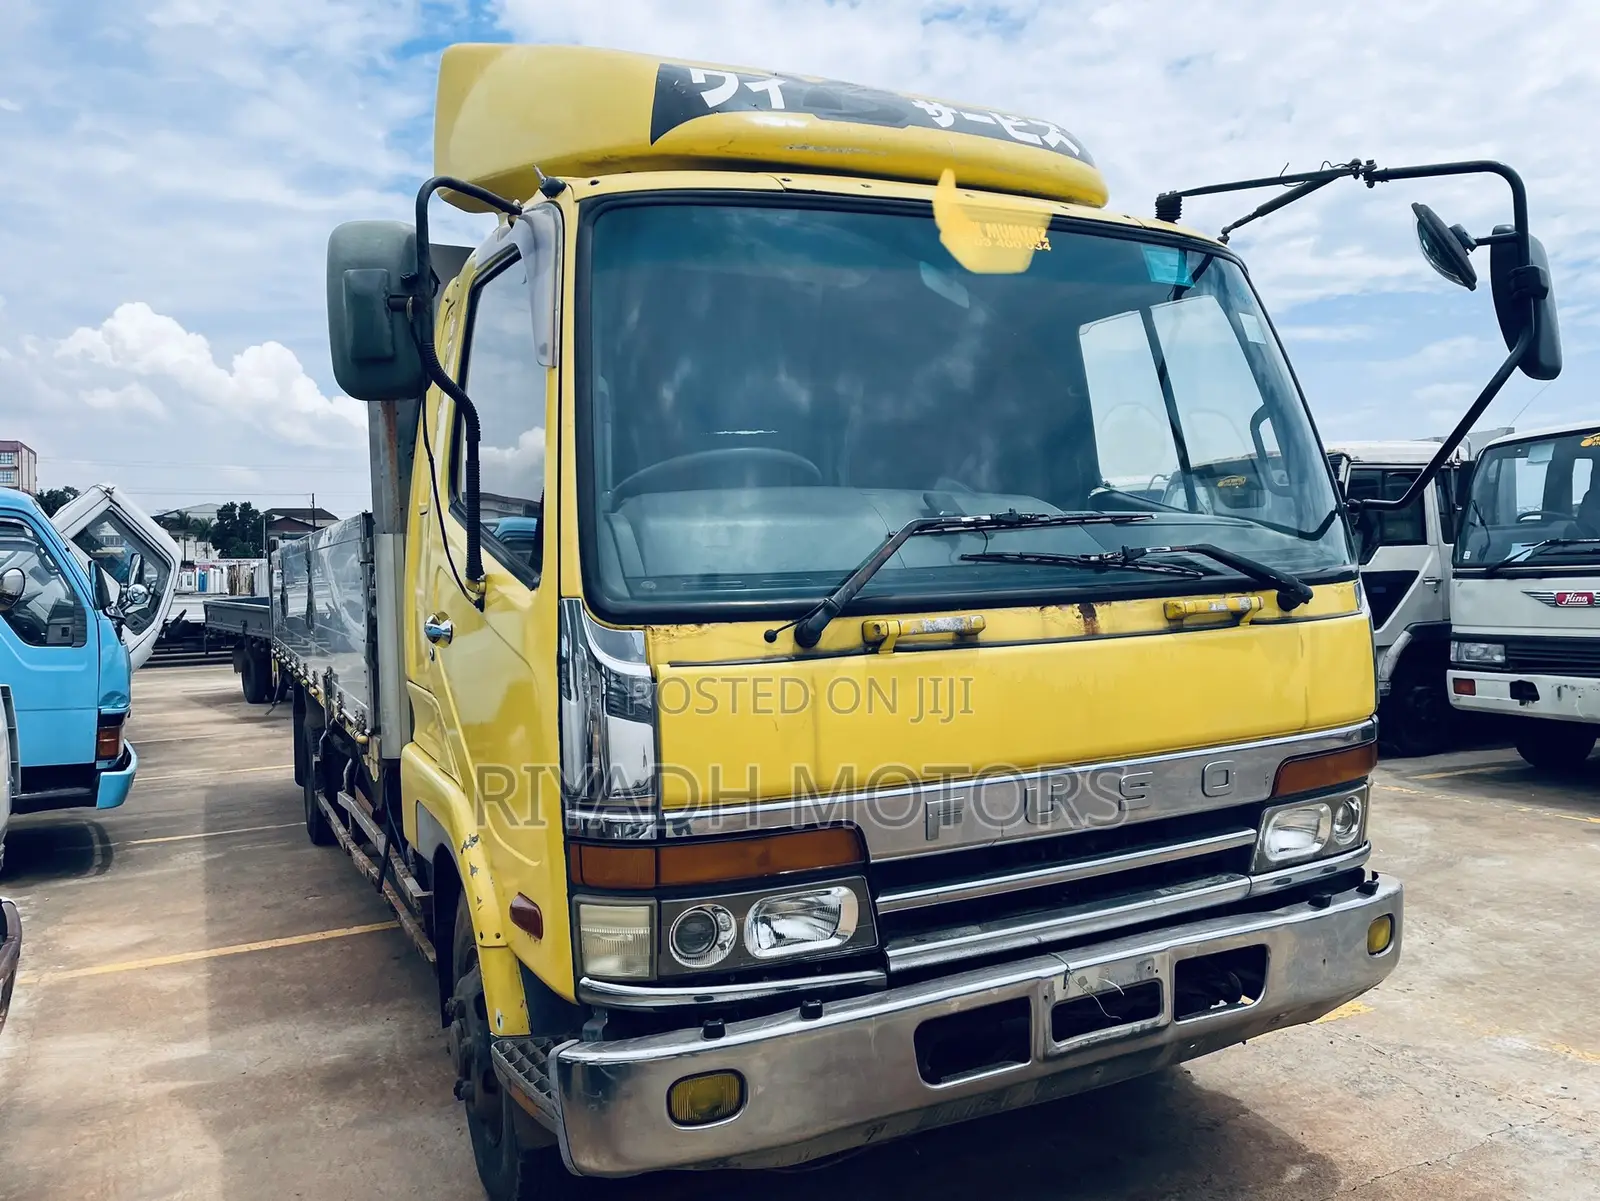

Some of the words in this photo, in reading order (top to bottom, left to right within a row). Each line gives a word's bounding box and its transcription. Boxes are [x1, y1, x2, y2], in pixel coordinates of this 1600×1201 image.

[911, 99, 1080, 156] サービス
[1562, 592, 1588, 604] Hino
[925, 760, 1236, 841] FUSO
